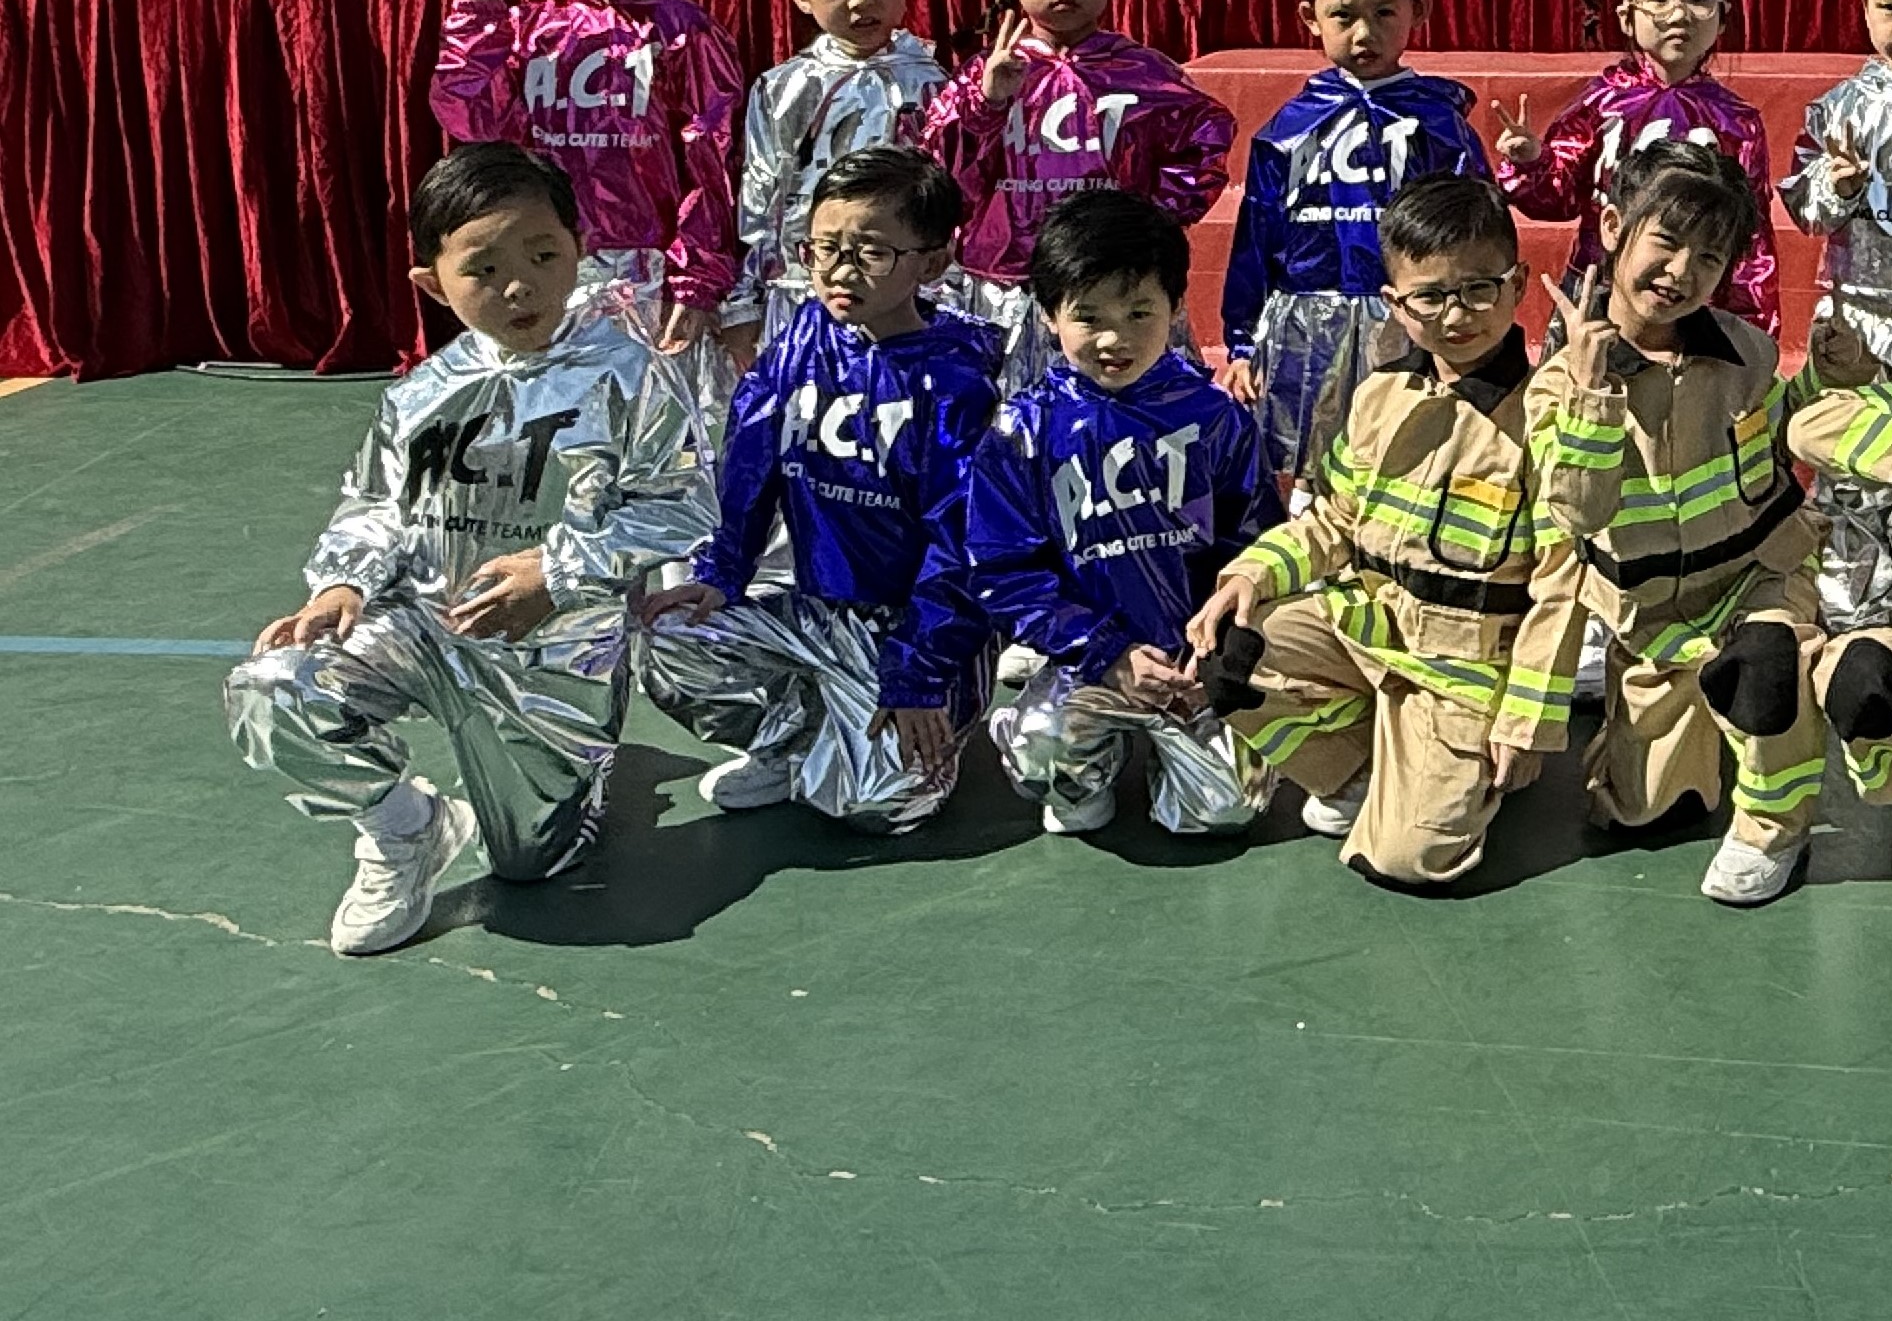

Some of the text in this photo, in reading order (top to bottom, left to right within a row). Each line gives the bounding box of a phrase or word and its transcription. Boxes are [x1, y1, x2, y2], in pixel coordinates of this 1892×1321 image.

[524, 42, 662, 118] A.C.T
[1003, 93, 1139, 161] A.C.T
[1287, 117, 1419, 207] A.C.T
[780, 382, 913, 478] A.C.T
[818, 481, 855, 503] CUTE
[857, 489, 900, 510] TEAM
[1052, 423, 1200, 551] A.C.T
